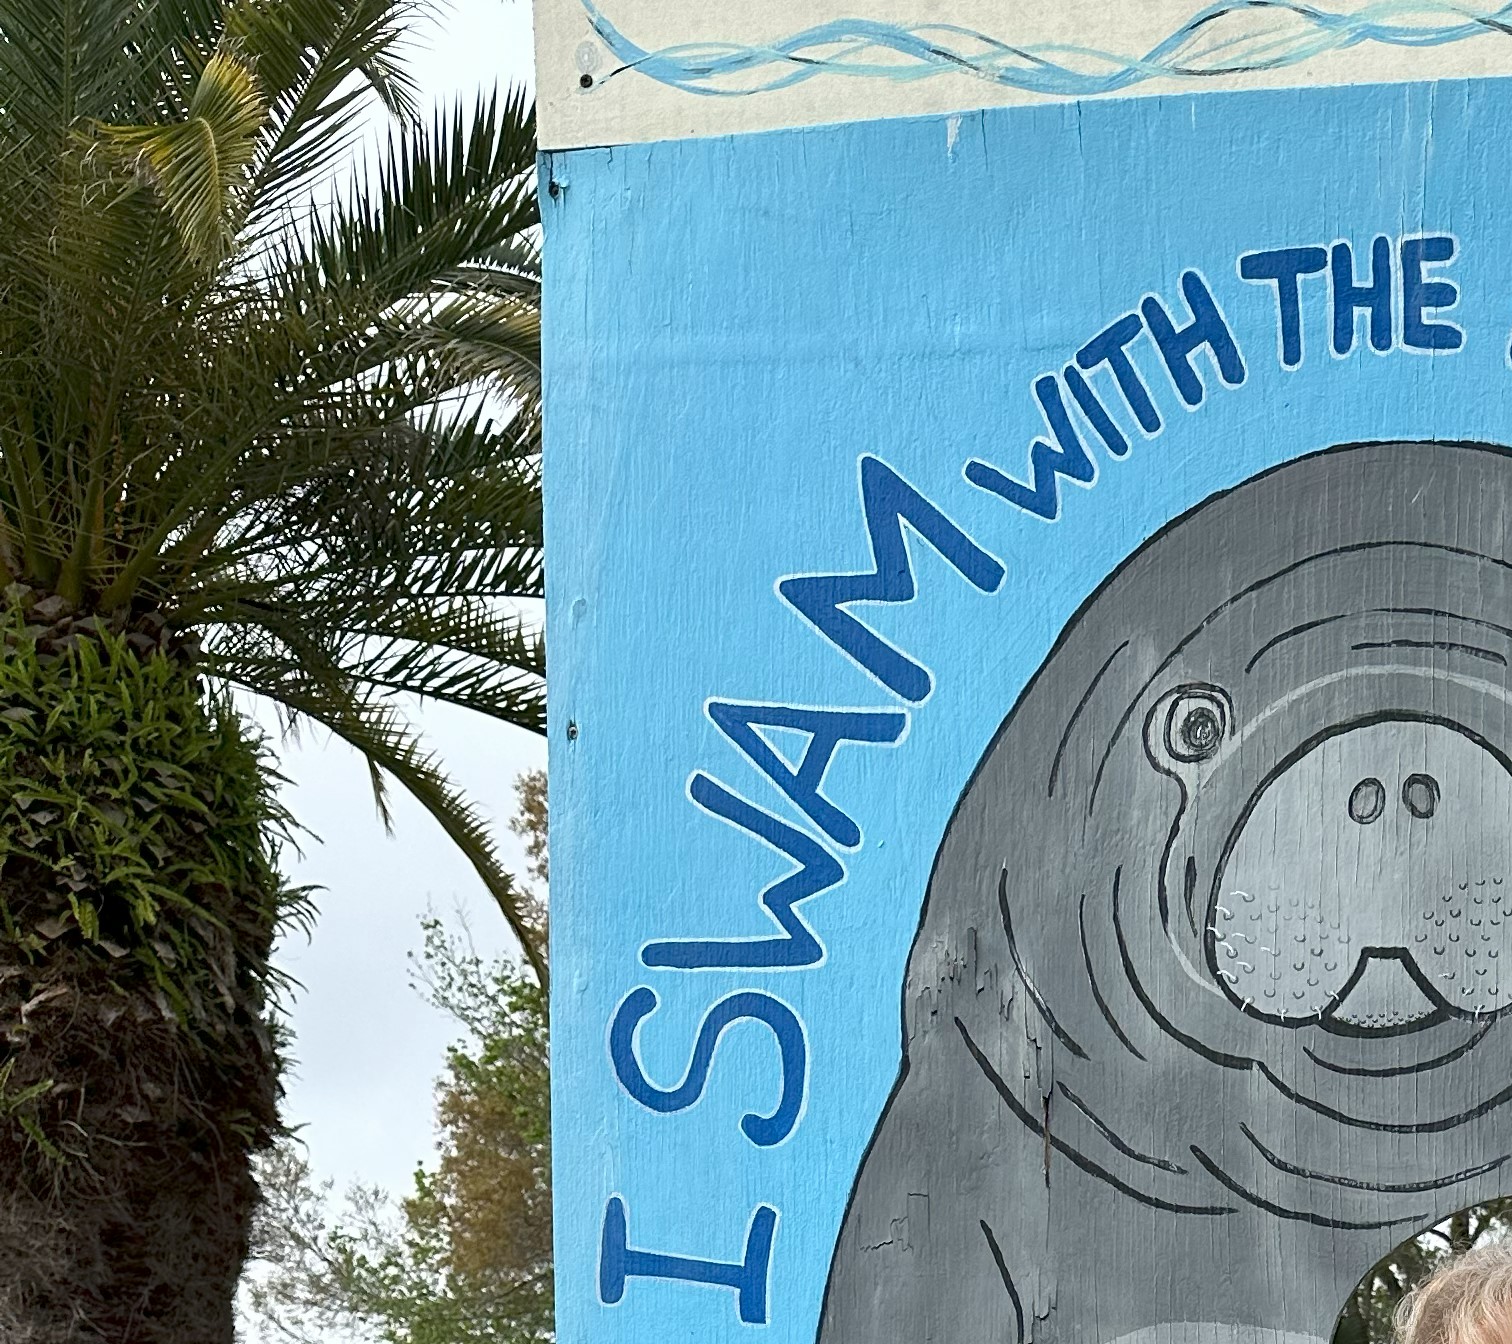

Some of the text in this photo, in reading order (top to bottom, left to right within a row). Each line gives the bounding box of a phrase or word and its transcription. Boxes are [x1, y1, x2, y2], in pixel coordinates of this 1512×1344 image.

[964, 270, 1246, 521] WITH
[1240, 236, 1463, 367] THE
[609, 456, 1006, 1147] SWAM
[599, 1196, 777, 1325] I
